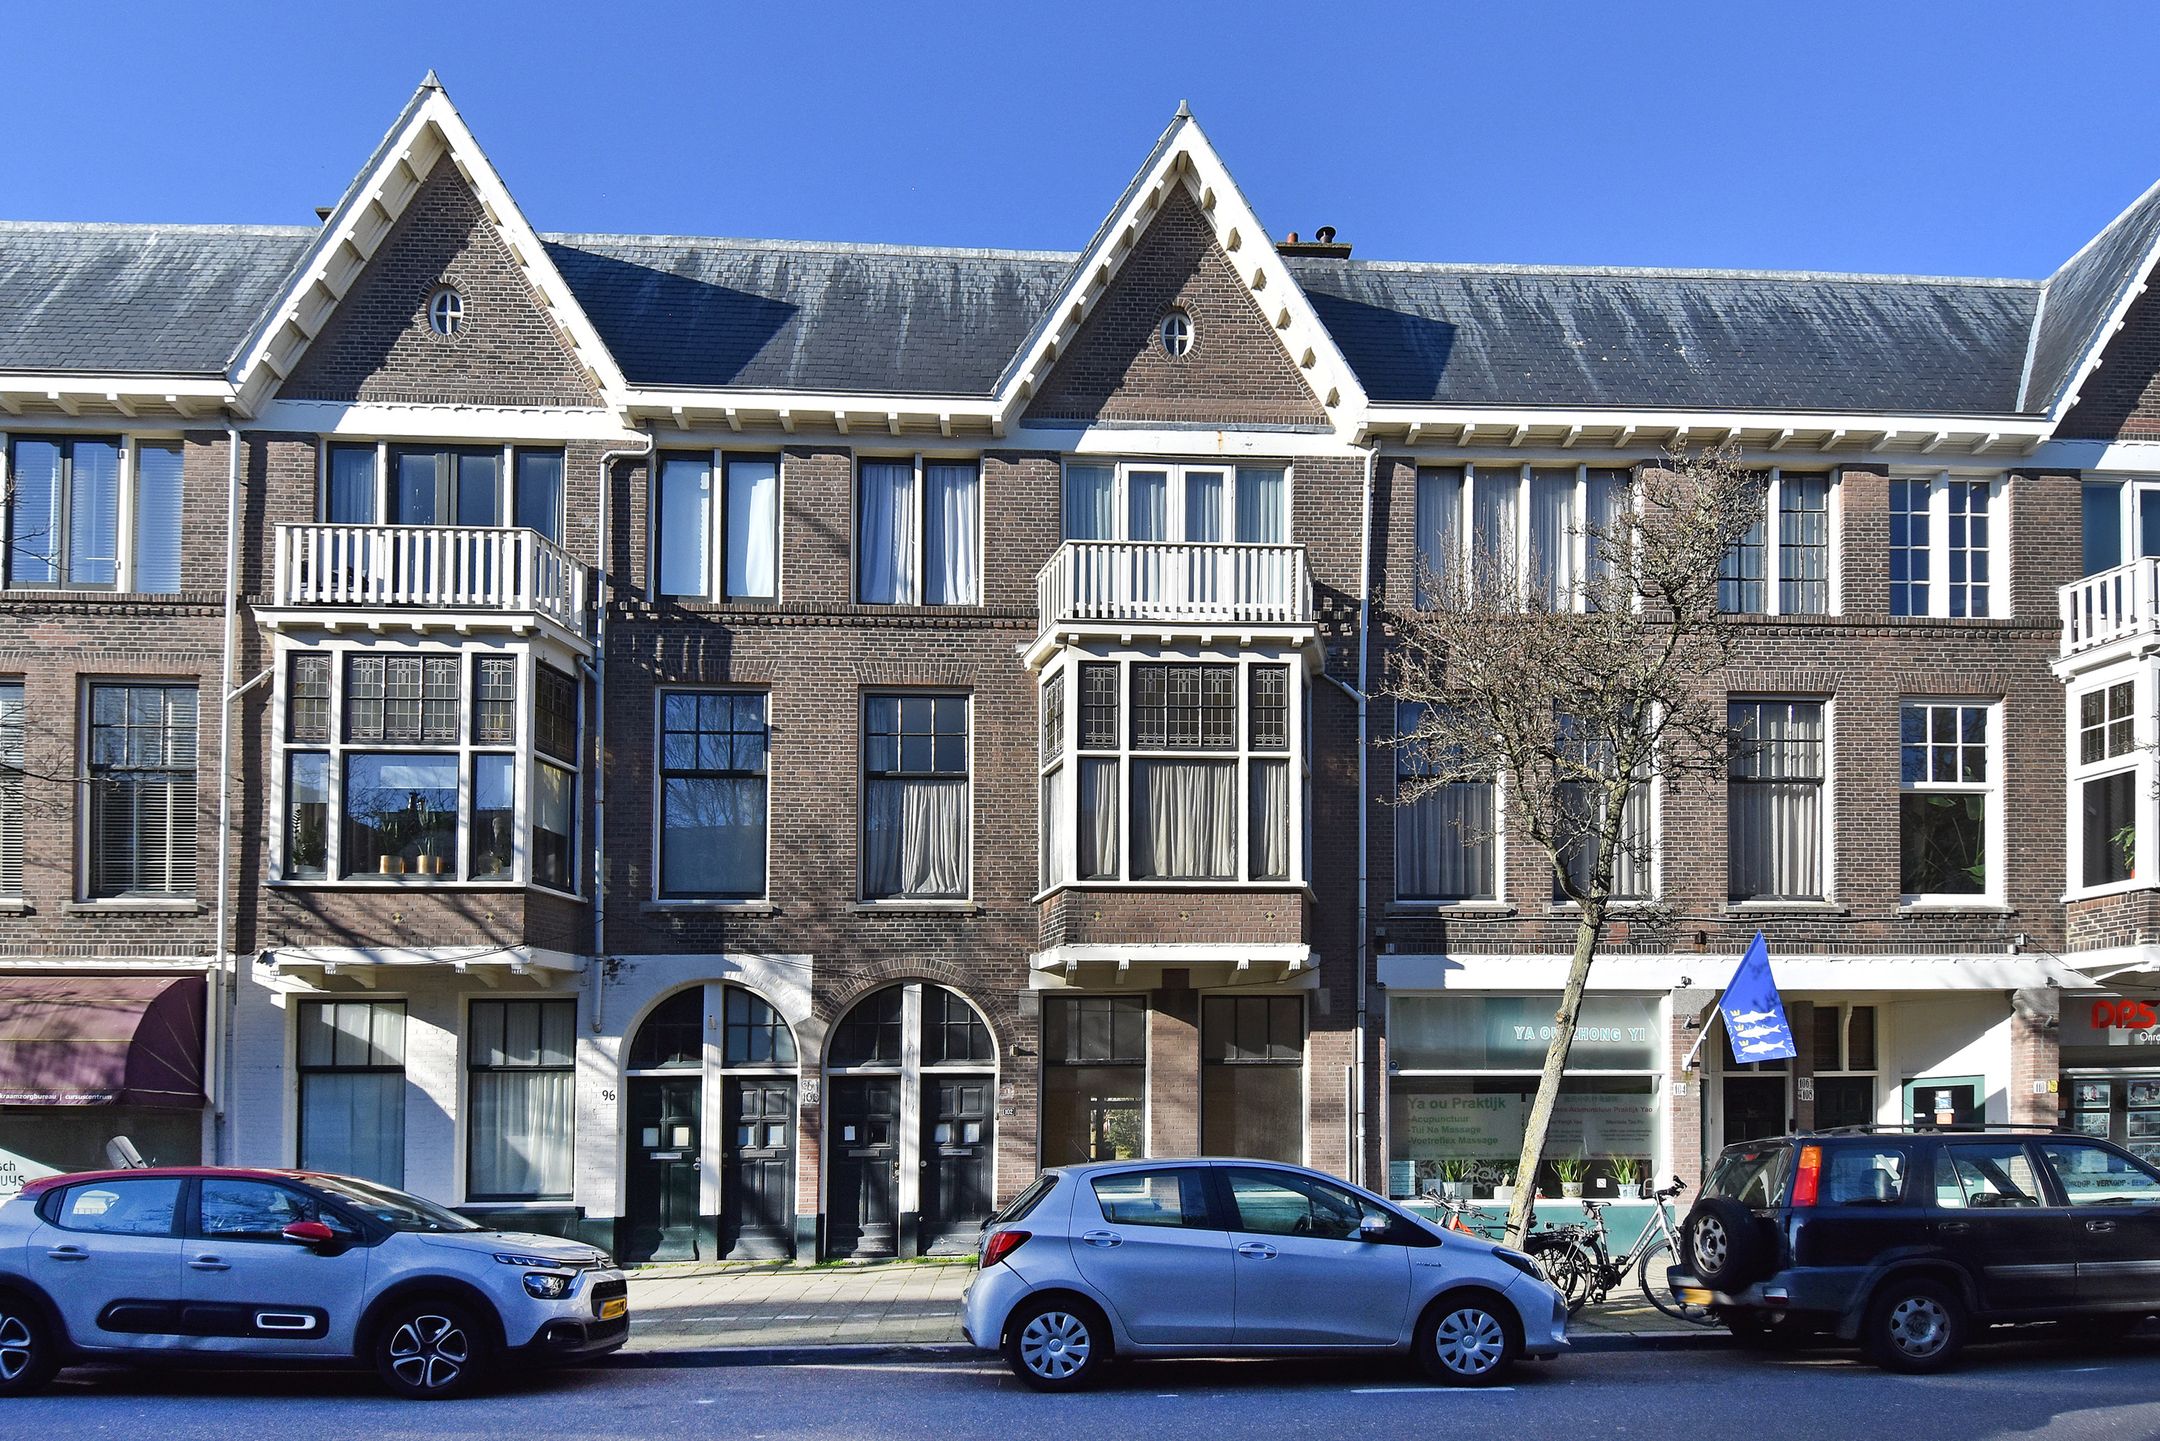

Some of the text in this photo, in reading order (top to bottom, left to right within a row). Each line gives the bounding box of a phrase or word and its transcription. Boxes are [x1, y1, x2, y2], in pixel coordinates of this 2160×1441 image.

[2091, 1000, 2157, 1029] DPS
[1514, 1026, 1535, 1040] YA
[1627, 1027, 1646, 1041] YI
[1675, 1084, 1686, 1095] 104
[602, 1090, 616, 1101] 96
[1408, 1097, 1506, 1111] Ya ou Praktijk
[1427, 1126, 1439, 1134] Na
[1442, 1126, 1481, 1136] Massage
[1460, 1137, 1498, 1146] Massage
